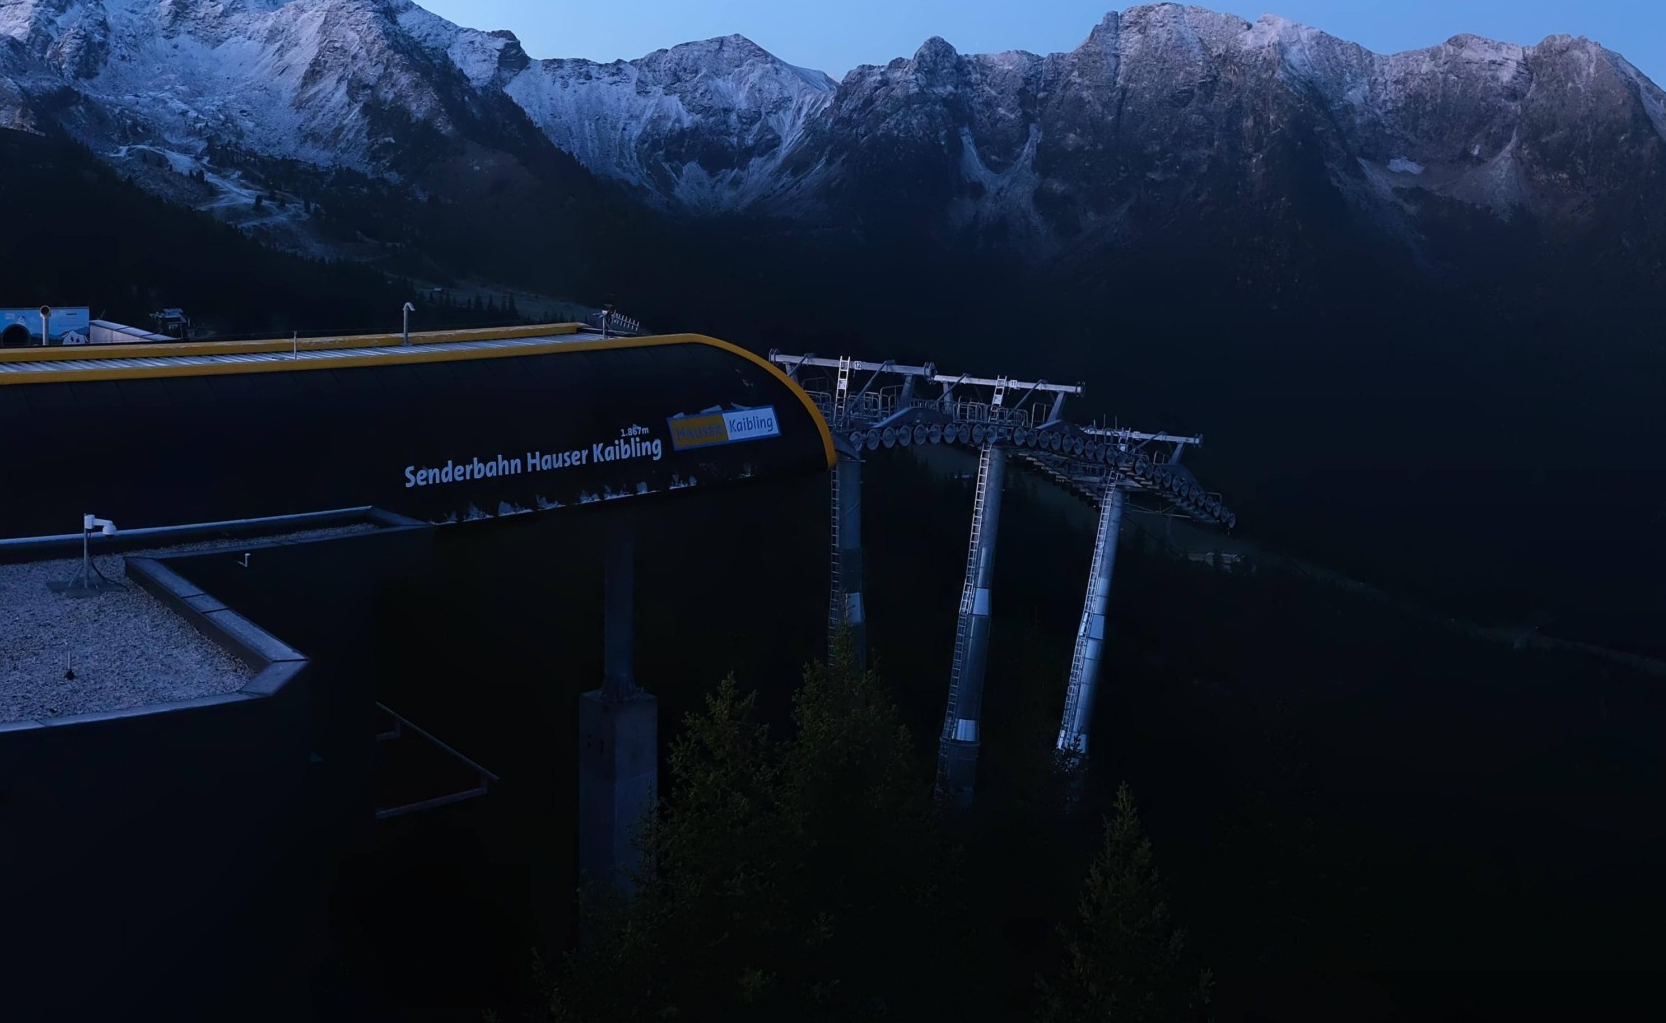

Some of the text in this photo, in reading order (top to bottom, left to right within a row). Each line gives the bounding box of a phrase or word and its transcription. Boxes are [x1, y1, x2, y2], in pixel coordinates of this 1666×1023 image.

[729, 416, 774, 433] Kaibling
[404, 437, 662, 488] Senderbahn Hauser Kaibling
